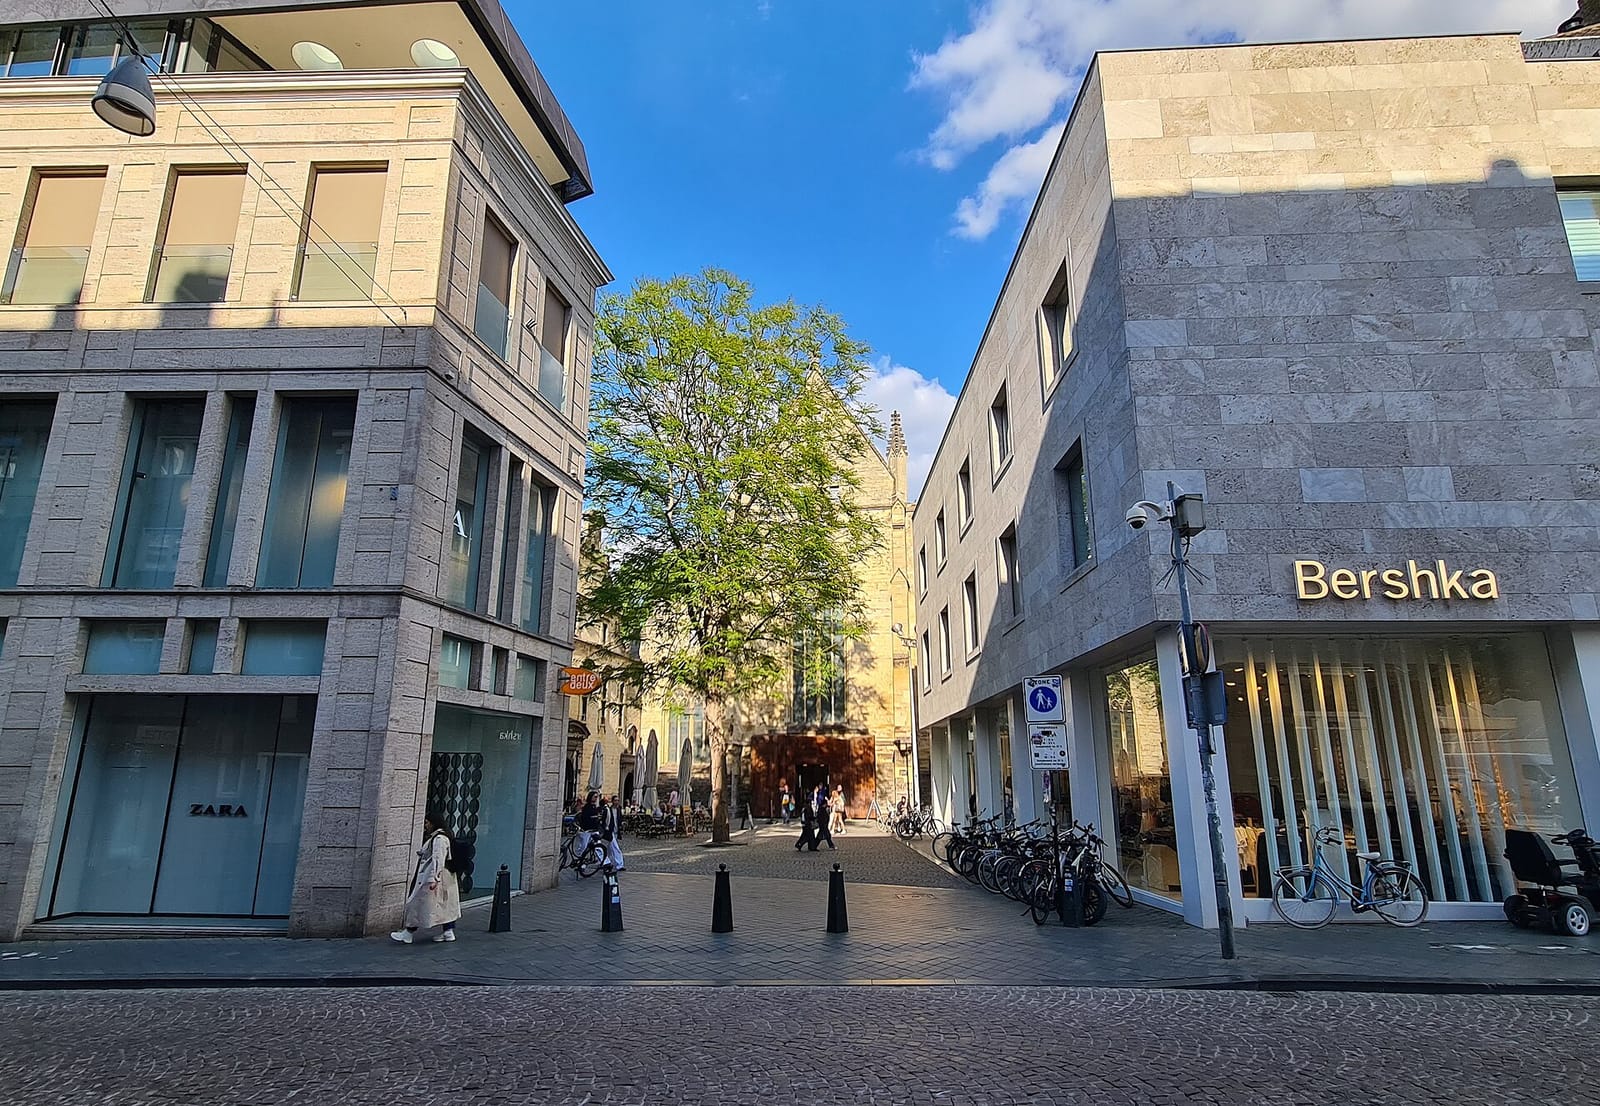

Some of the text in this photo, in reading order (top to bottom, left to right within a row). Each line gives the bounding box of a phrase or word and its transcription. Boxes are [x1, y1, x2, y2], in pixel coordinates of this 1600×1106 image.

[1293, 559, 1499, 599] Bershka
[570, 673, 596, 682] entre
[570, 680, 594, 690] deux
[190, 803, 248, 817] ZARA
